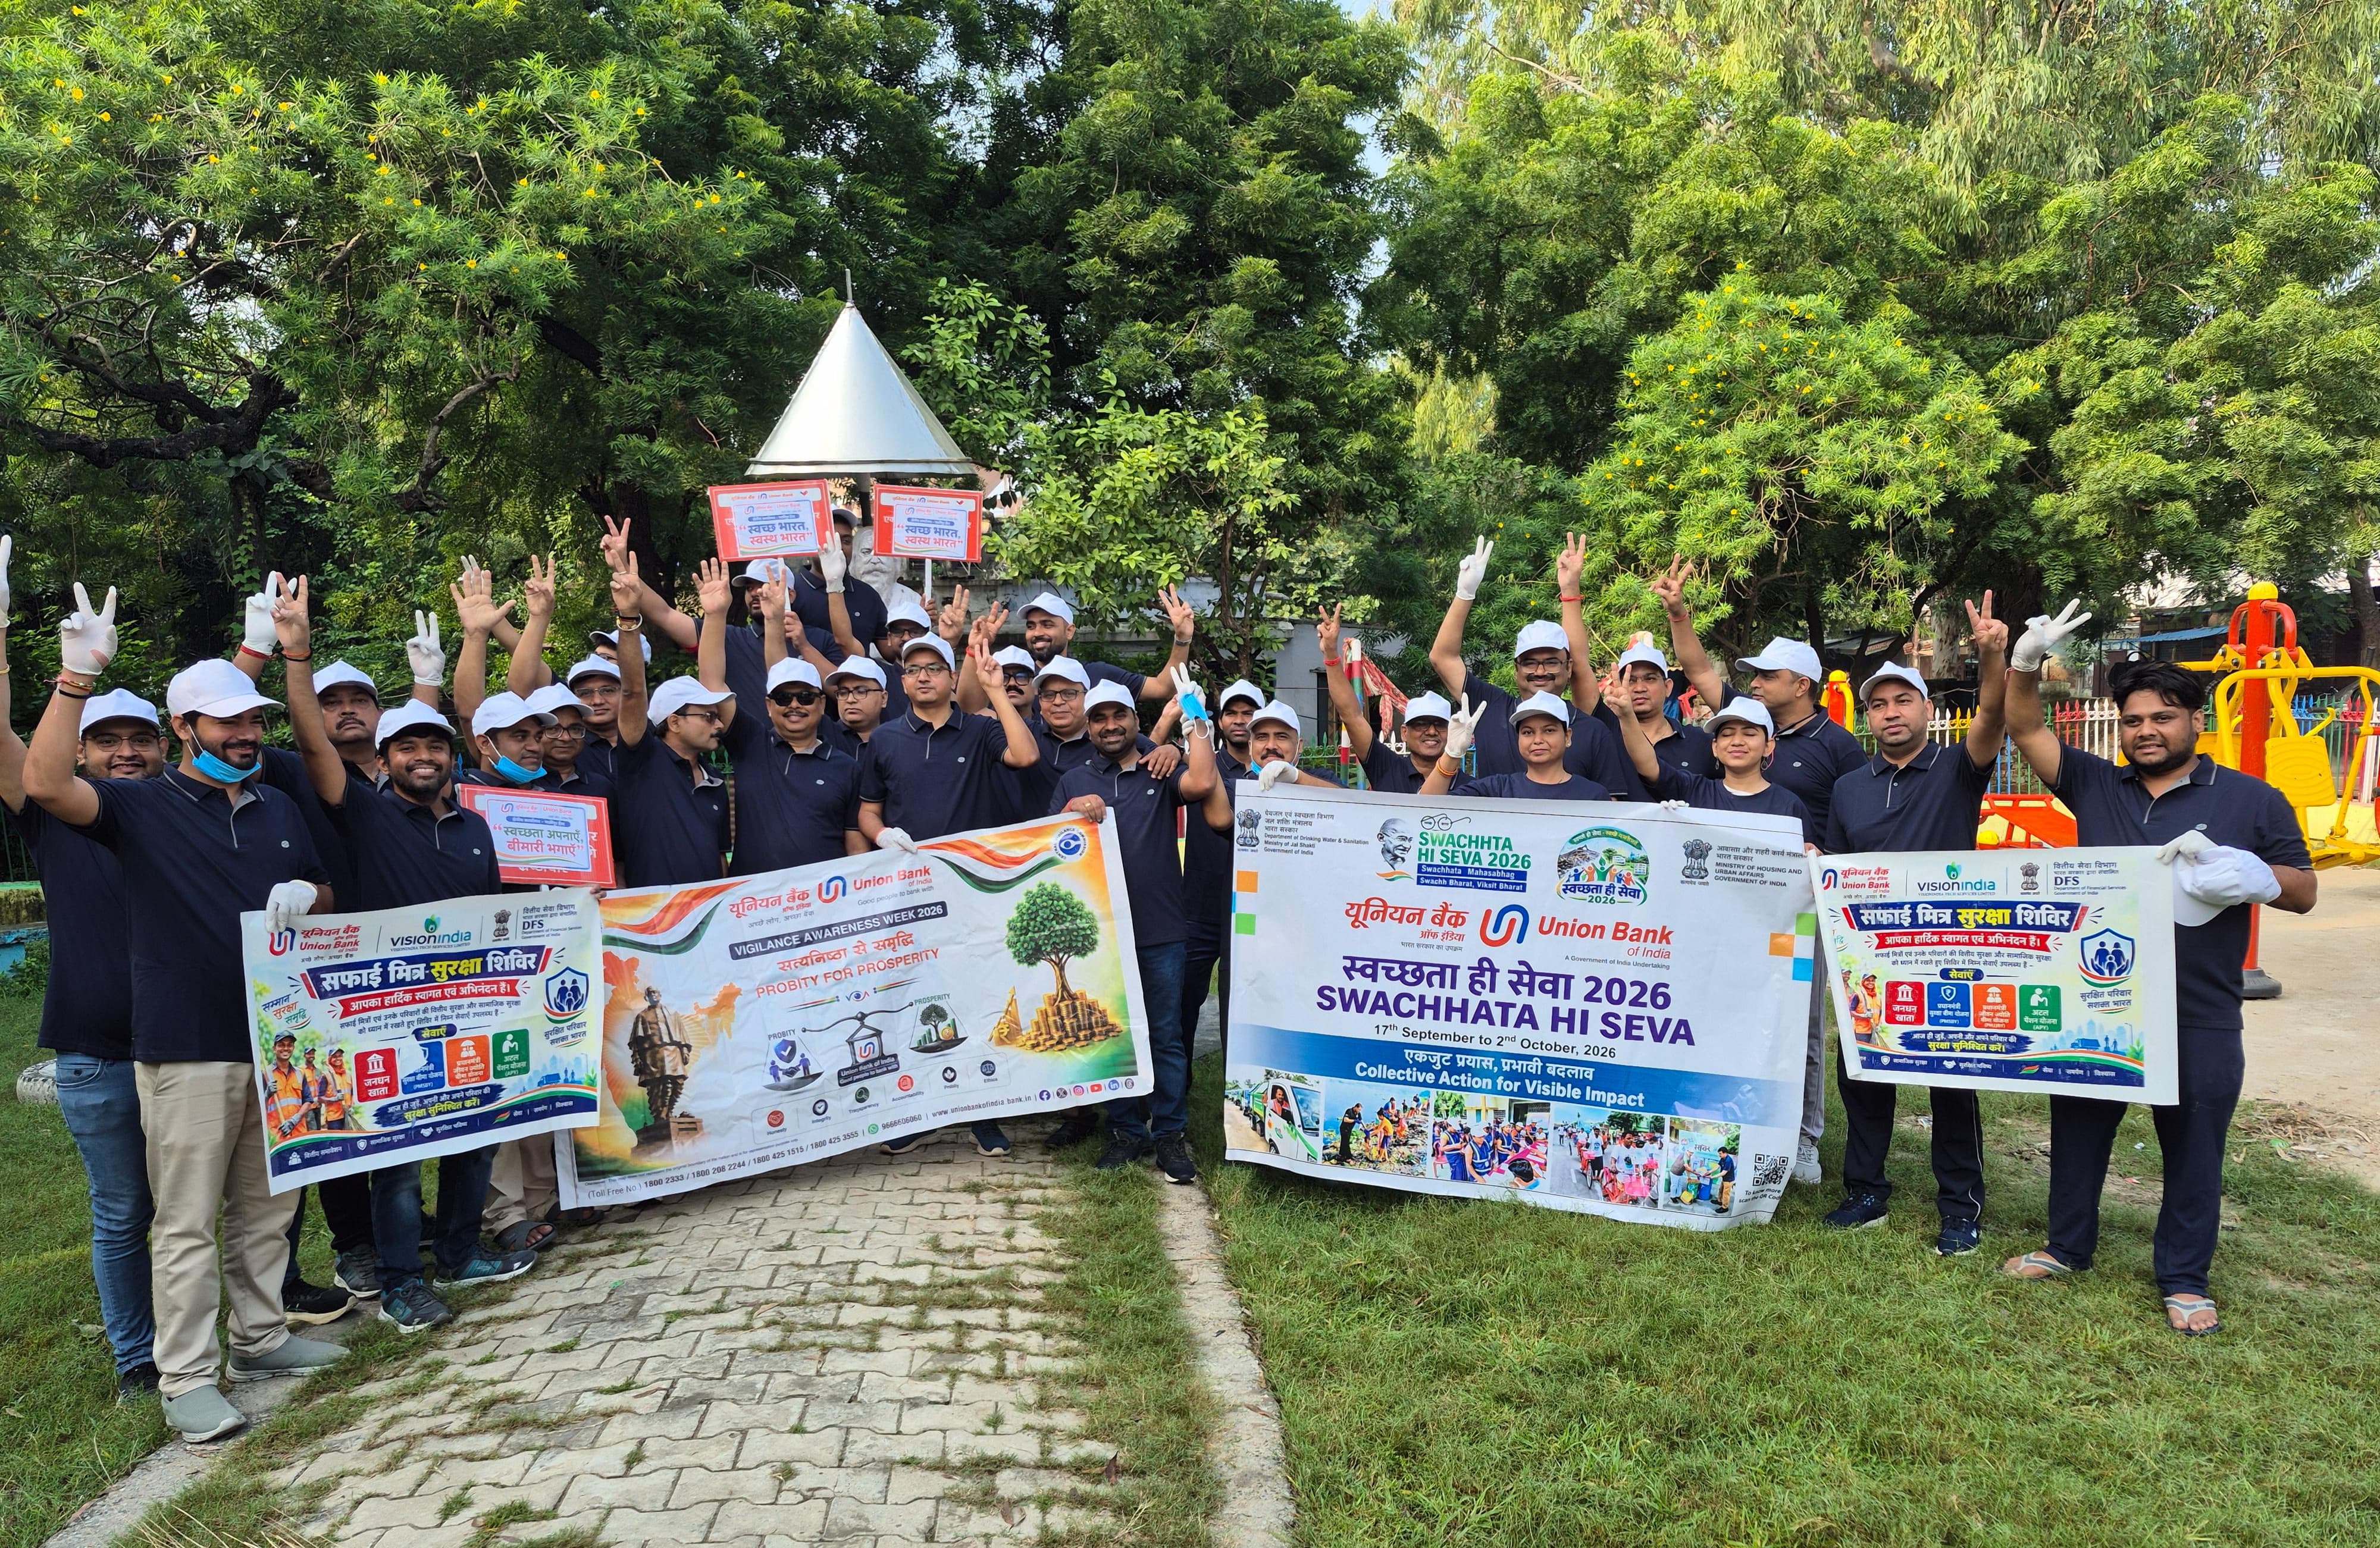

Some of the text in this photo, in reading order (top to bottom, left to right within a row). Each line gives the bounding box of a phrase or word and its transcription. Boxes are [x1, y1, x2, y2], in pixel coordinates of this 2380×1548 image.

[750, 535, 778, 545] स्वस्थ
[904, 536, 930, 546] स्वस्थ
[508, 838, 544, 853] बीमारी
[1418, 831, 1513, 851] SWACHHTA
[1418, 848, 1532, 869] HI SEVA 2026
[853, 866, 931, 890] Union Bank
[1421, 865, 1515, 879] Swachhata Mahasabhag
[1841, 867, 1871, 878] यूनियन
[1449, 880, 1475, 888] Bharat,
[1714, 876, 1758, 884] GOVERNMENT
[2054, 876, 2080, 886] DFS
[907, 887, 921, 895] bank
[1562, 883, 1642, 899] स्वच्छता ही सेवा
[729, 888, 810, 918] यूनियन बैंक
[1587, 895, 1616, 904] 2026
[1344, 897, 1470, 929] यूनियन बैंक
[1859, 903, 2071, 929] सफाई मित्र सुरक्षा शिविर
[300, 927, 340, 938] यूनियन
[343, 925, 361, 935] बैंक
[522, 920, 544, 930] DFS
[734, 905, 943, 956] VIGILANCE AWARENESS WEEK 2026
[1538, 916, 1674, 945] Union Bank
[1419, 929, 1465, 942] ऑफ इंडिया
[1885, 935, 1912, 944] आपका
[1914, 933, 1939, 944] हार्दिक
[1941, 933, 1969, 944] स्वागत
[1971, 933, 1985, 944] एवं
[1987, 933, 2027, 945] अभिनंदन
[300, 939, 359, 951] Union Bank
[776, 930, 915, 972] सत्यनिष्ठा से समृद्धि
[1627, 947, 1671, 959] of India
[1571, 955, 1607, 964] Government
[1633, 961, 1670, 970] Undertaking
[320, 951, 537, 991] सफाई मित्र सुरक्षा शिविर
[756, 948, 939, 998] PROBITY FOR PROSPERITY
[1342, 955, 1671, 1010] स्वच्छता ही सेवा 2026
[915, 994, 951, 1005] PROSPERITY
[2080, 989, 2132, 1001] सुरक्षित परिवार
[262, 994, 292, 1012] सम्मान
[273, 1001, 299, 1019] सुरक्षा
[1892, 1004, 1917, 1013] जनधन
[1316, 985, 1696, 1046] SWACHHATA HI SEVA
[1896, 1013, 1915, 1021] खाता
[768, 1029, 796, 1041] PROBITY
[1374, 1023, 1616, 1058] 17th September to 2nd October, 2026
[1404, 1049, 1595, 1081] एकजुट प्रयास, प्रभावी बदलाव
[1355, 1061, 1645, 1107] Collective Action for Visible Impact
[588, 1190, 606, 1199] (Toll
[607, 1188, 624, 1196] Free
[626, 1184, 642, 1193] No.)
[644, 1179, 663, 1188] 1800
[665, 1174, 684, 1184] 2333
[691, 1169, 710, 1179] 1800
[712, 1165, 726, 1174] 208
[728, 1160, 746, 1170] 2244
[753, 1155, 770, 1164] 1800
[772, 1151, 785, 1160] 425
[787, 1146, 804, 1156] 1515
[810, 1140, 827, 1149] 1800
[828, 1136, 841, 1145] 425
[843, 1130, 859, 1140] 3555
[881, 1114, 922, 1130] 9666606060
